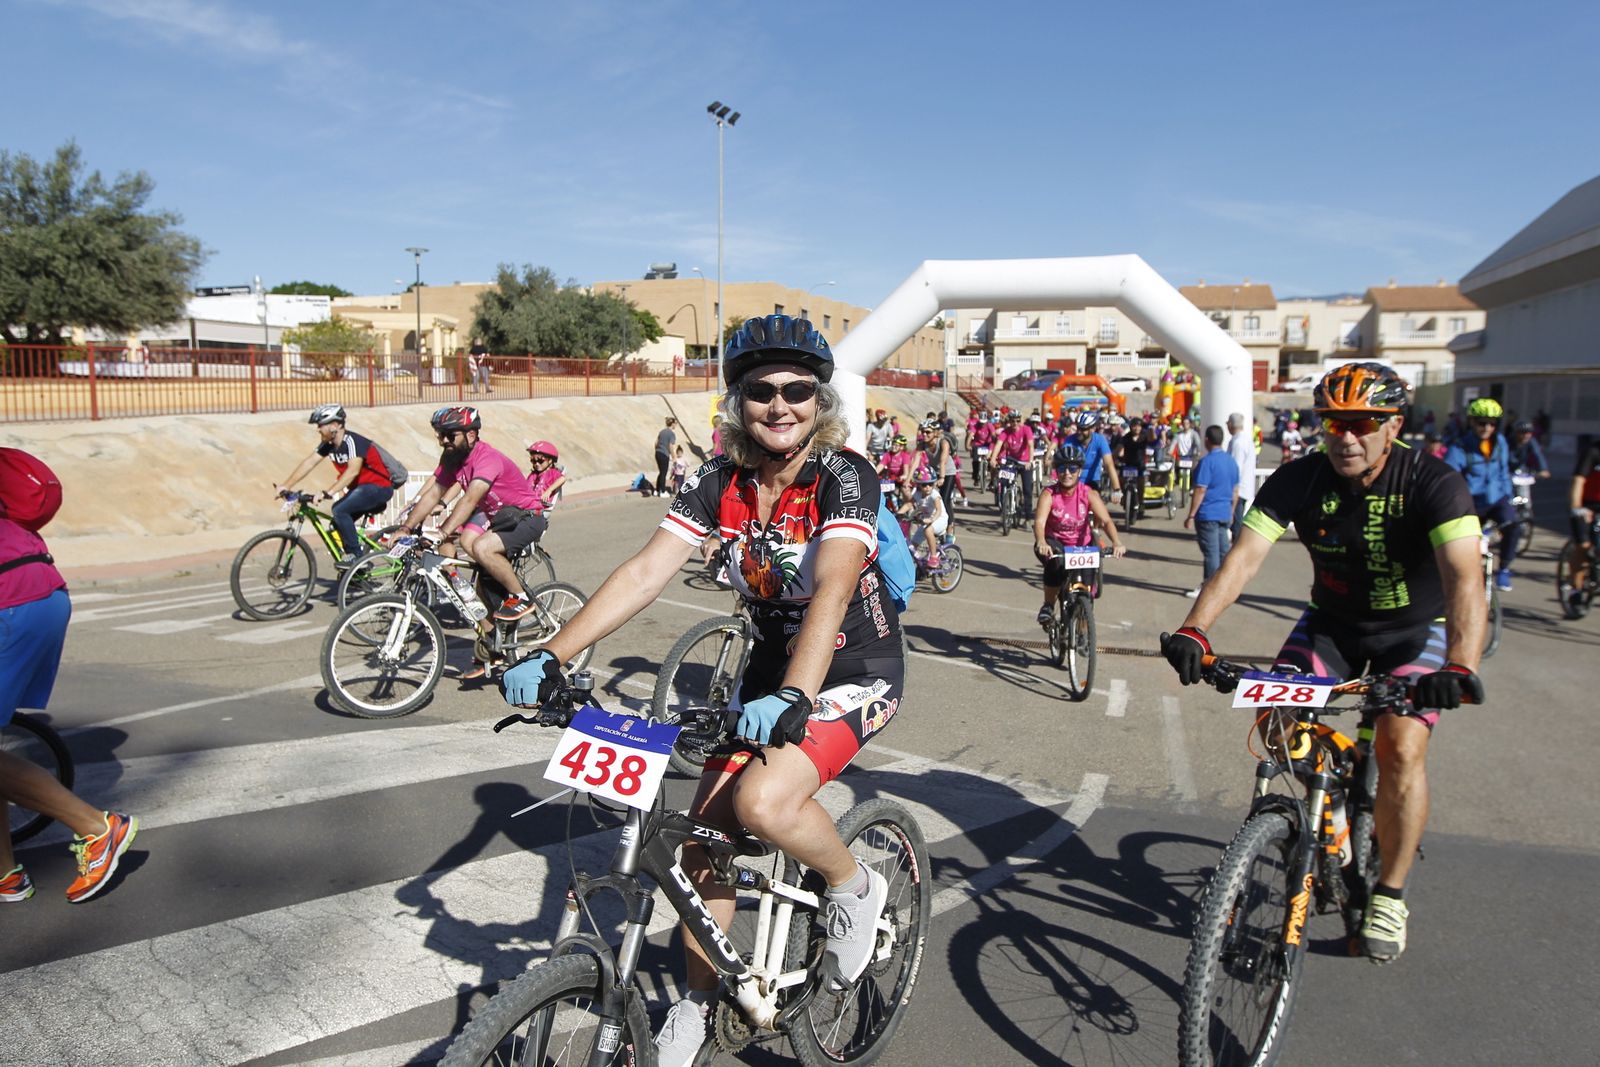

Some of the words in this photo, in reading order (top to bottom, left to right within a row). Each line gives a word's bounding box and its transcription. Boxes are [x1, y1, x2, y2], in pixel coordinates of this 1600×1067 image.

[1068, 555, 1095, 567] 604
[1369, 577, 1398, 610] Bike
[1242, 683, 1316, 703] 428
[594, 725, 621, 737] DIPUTACIÓN
[628, 735, 648, 744] ALMERÍA
[559, 740, 648, 796] 438
